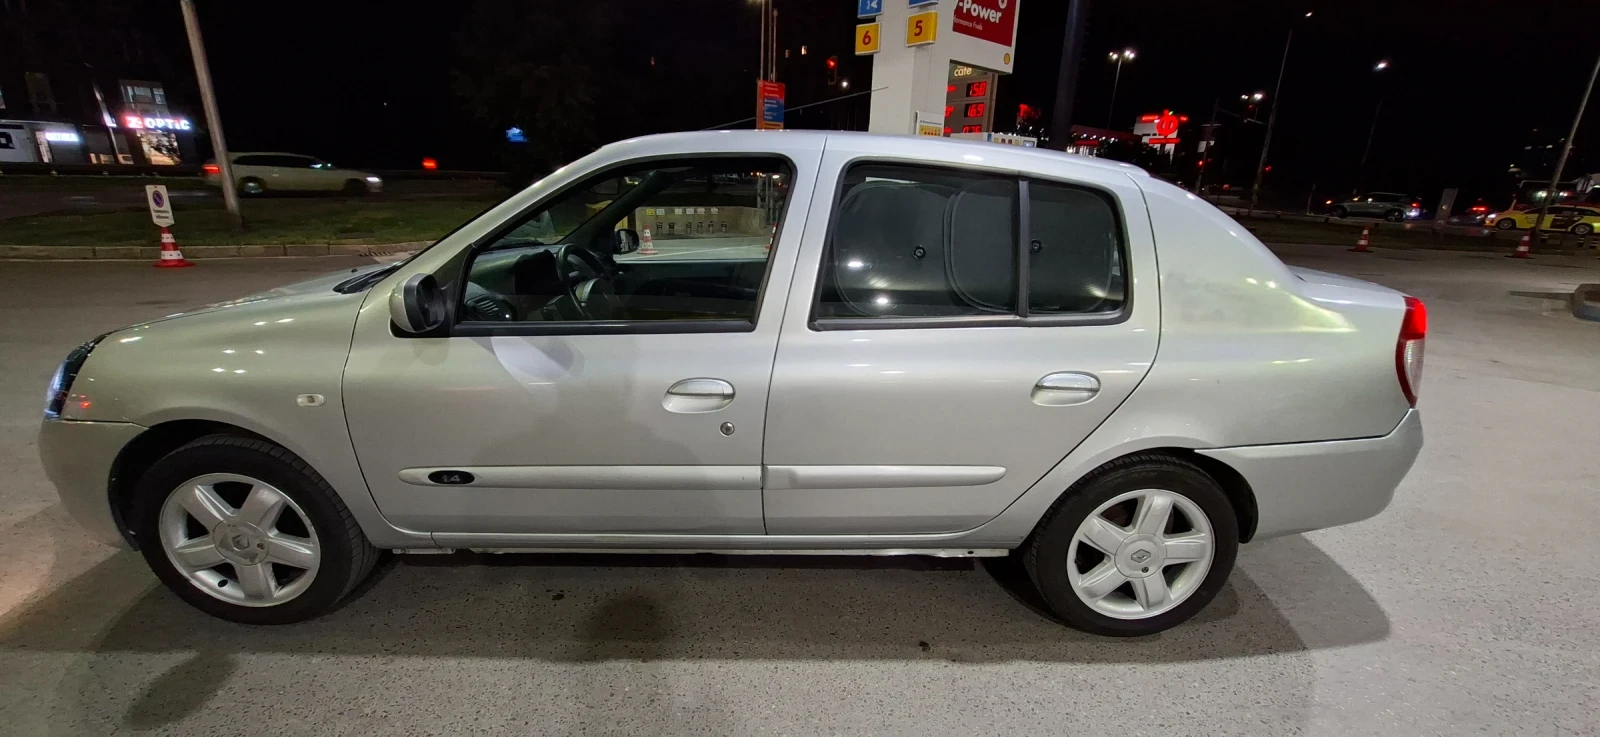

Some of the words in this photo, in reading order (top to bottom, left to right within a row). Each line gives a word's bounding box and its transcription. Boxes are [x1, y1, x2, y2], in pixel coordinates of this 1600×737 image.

[953, 0, 1003, 24] -Power
[914, 20, 923, 37] 5
[862, 30, 872, 46] 6
